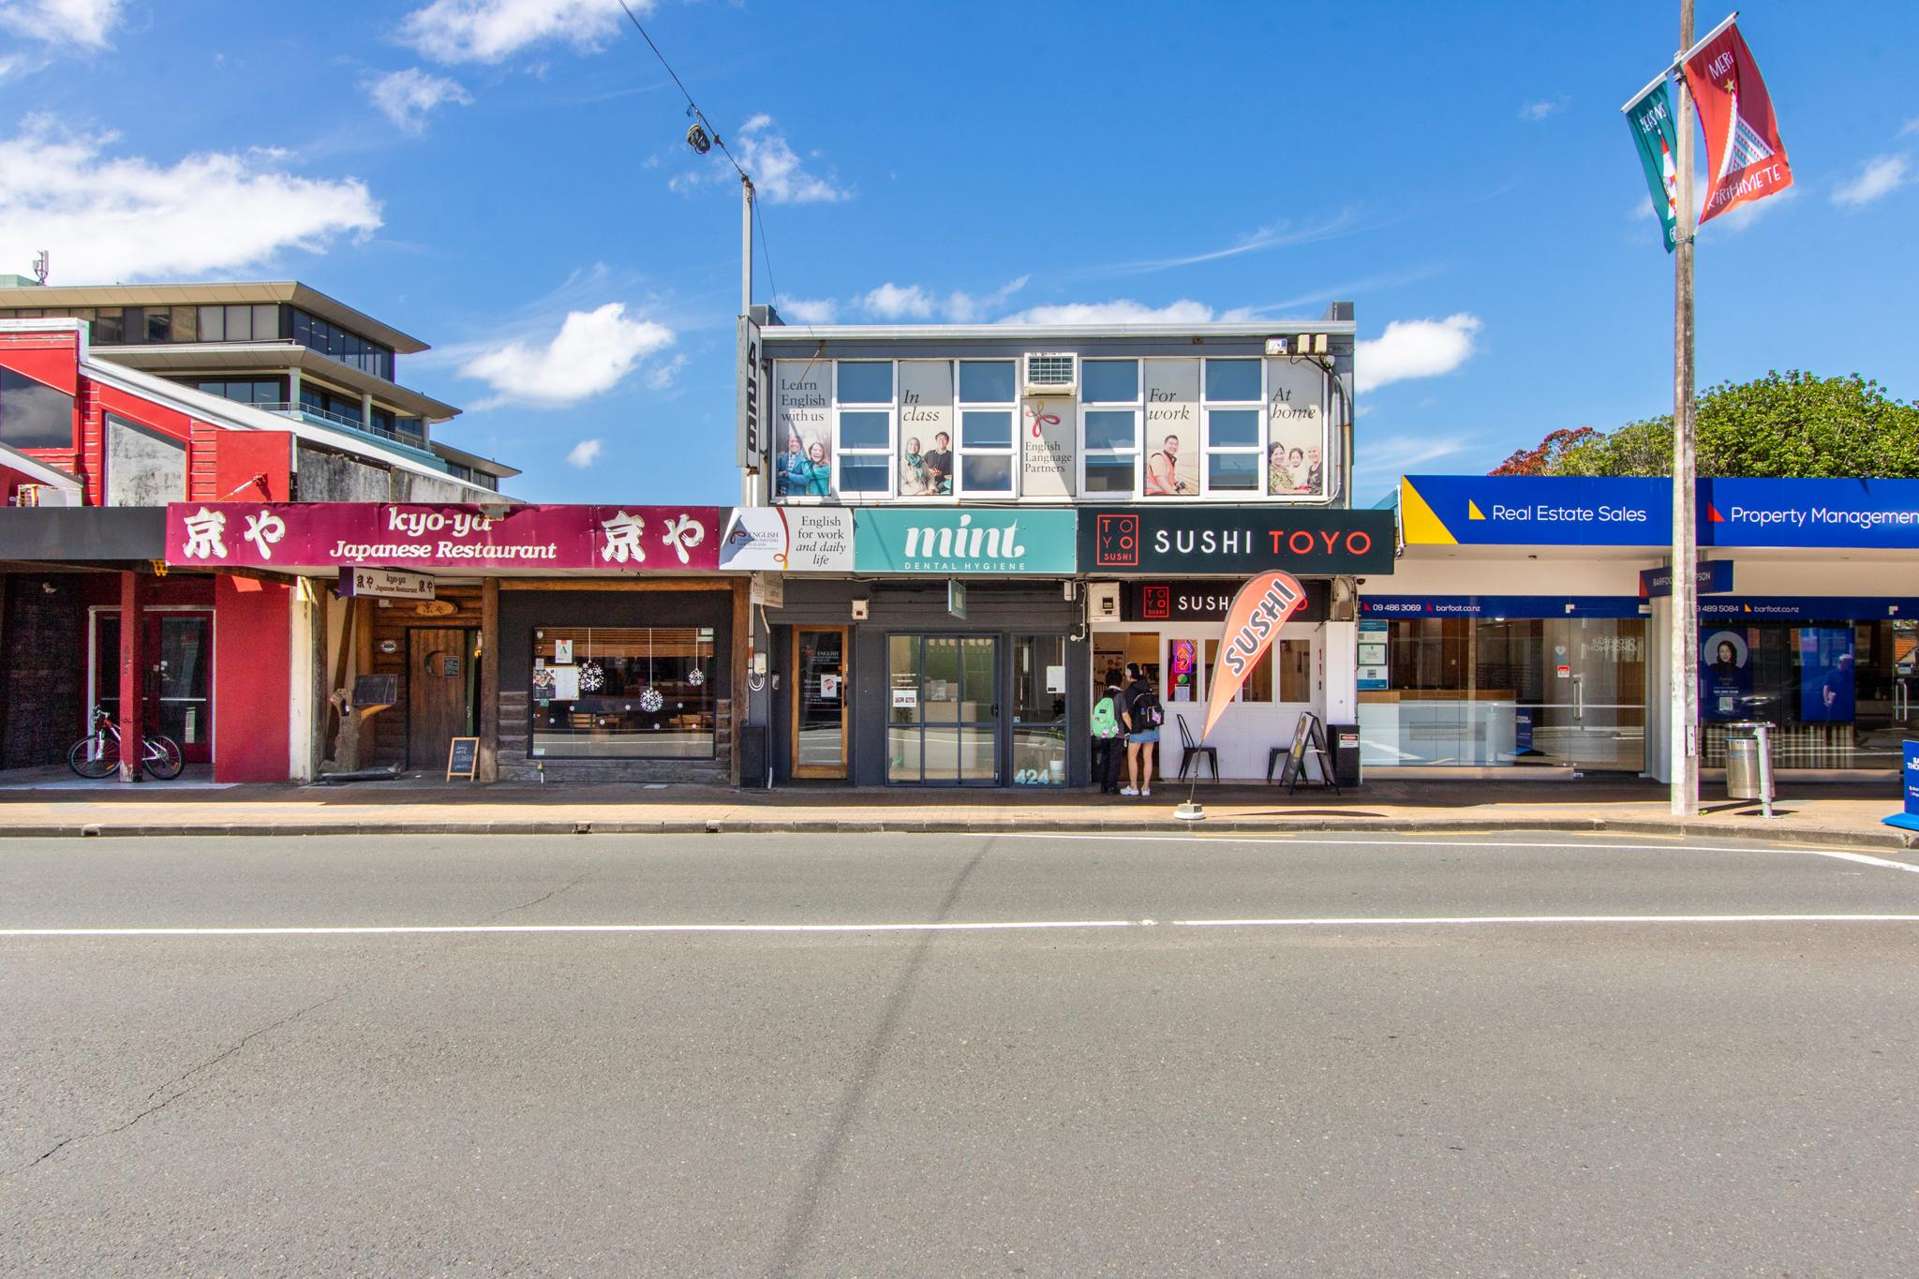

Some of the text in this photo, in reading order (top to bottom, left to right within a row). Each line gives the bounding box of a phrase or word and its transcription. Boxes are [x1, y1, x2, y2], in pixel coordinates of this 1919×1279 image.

[781, 379, 817, 391] Learn
[781, 394, 826, 408] English
[903, 390, 920, 404] In
[1149, 387, 1177, 403] For
[1272, 387, 1293, 401] At
[781, 410, 824, 422] with us
[903, 406, 940, 422] class
[1148, 405, 1191, 421] work
[1271, 404, 1317, 420] home
[1025, 440, 1061, 453] English
[1025, 453, 1073, 465] Language
[1025, 463, 1065, 473] Partners
[1493, 505, 1648, 522] Real Estate Sales
[1731, 506, 1807, 528] Property
[388, 507, 492, 537] kyo-ya
[801, 516, 841, 528] English
[183, 507, 286, 560] 京や
[601, 511, 705, 564] 京や
[798, 530, 845, 539] for work
[904, 514, 1025, 558] mint
[796, 541, 847, 555] and daily
[1154, 529, 1373, 556] SUSHI TOYO
[329, 541, 557, 561] Japanese Restaurant
[1104, 553, 1132, 561] SUSHI
[812, 555, 830, 567] life
[904, 562, 1025, 570] DENTAL HYGIENE
[1178, 595, 1233, 611] SUSH
[1372, 604, 1383, 612] 09
[1435, 604, 1481, 612] barfoot.co.nz
[1702, 604, 1717, 613] 489
[1719, 604, 1739, 613] 5084
[1754, 604, 1800, 613] barfoot.co.nz
[1224, 579, 1296, 677] SUSHI
[1013, 768, 1049, 785] 424
